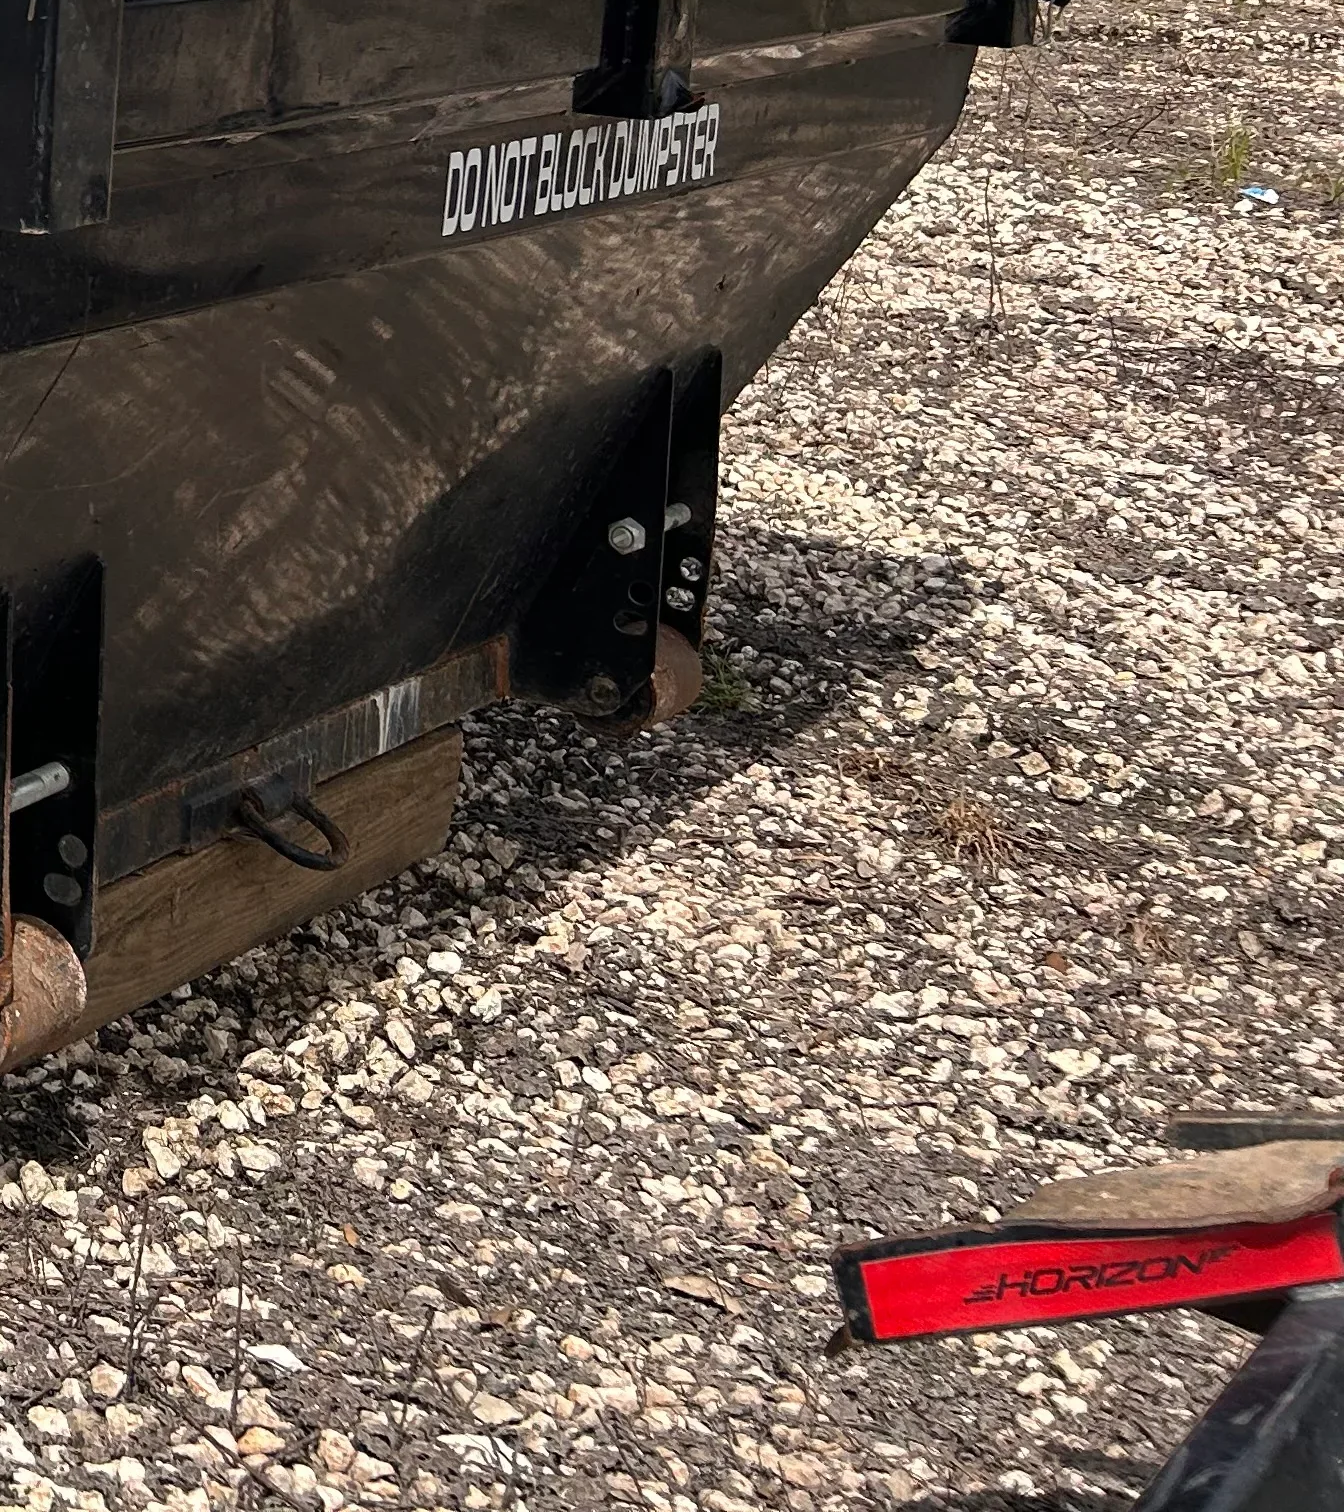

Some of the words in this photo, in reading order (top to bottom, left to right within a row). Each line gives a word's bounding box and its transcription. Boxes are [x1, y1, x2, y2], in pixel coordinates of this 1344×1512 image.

[441, 147, 483, 237] DO
[481, 136, 538, 228] NOT
[534, 122, 612, 216] BLOCK
[608, 102, 721, 200] DUMPSTER
[994, 1250, 1211, 1302] HORIZON
